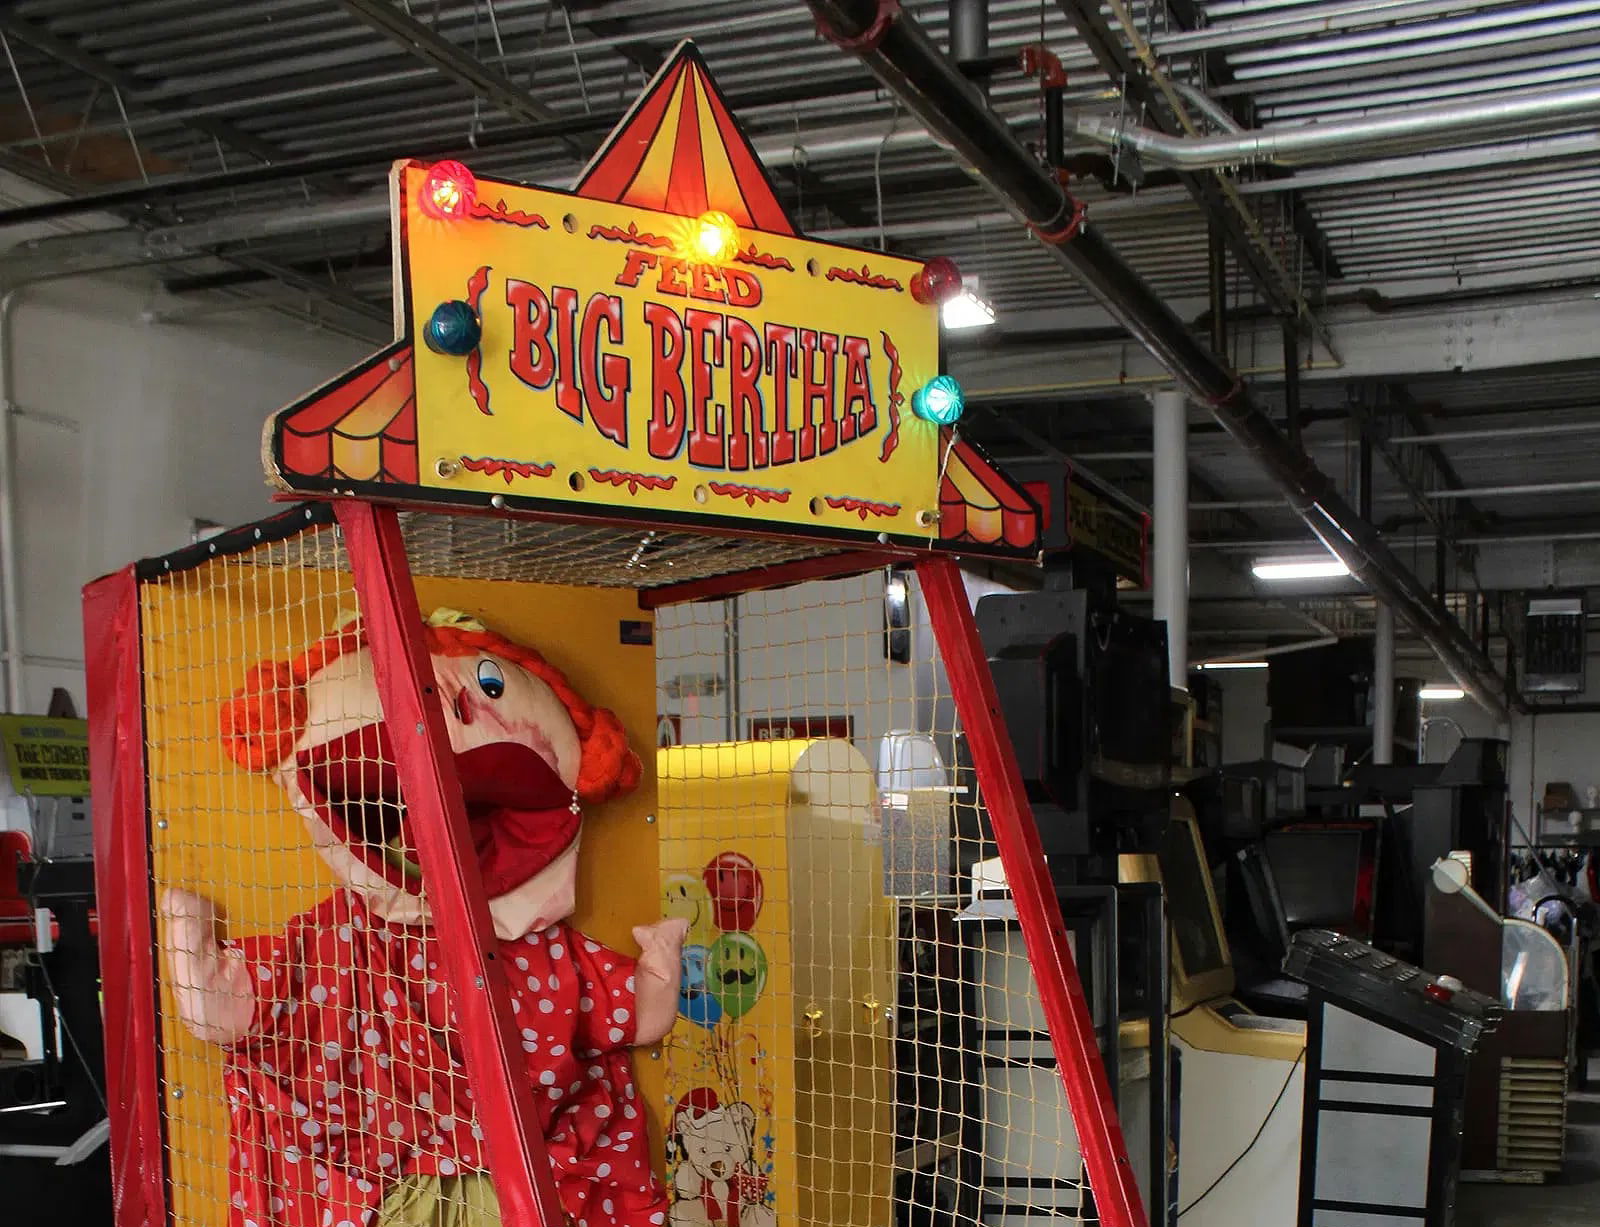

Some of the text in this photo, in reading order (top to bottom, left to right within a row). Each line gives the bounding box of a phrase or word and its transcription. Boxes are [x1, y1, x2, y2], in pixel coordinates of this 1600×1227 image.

[616, 249, 763, 308] FEED
[505, 278, 877, 472] BIG BERTHA
